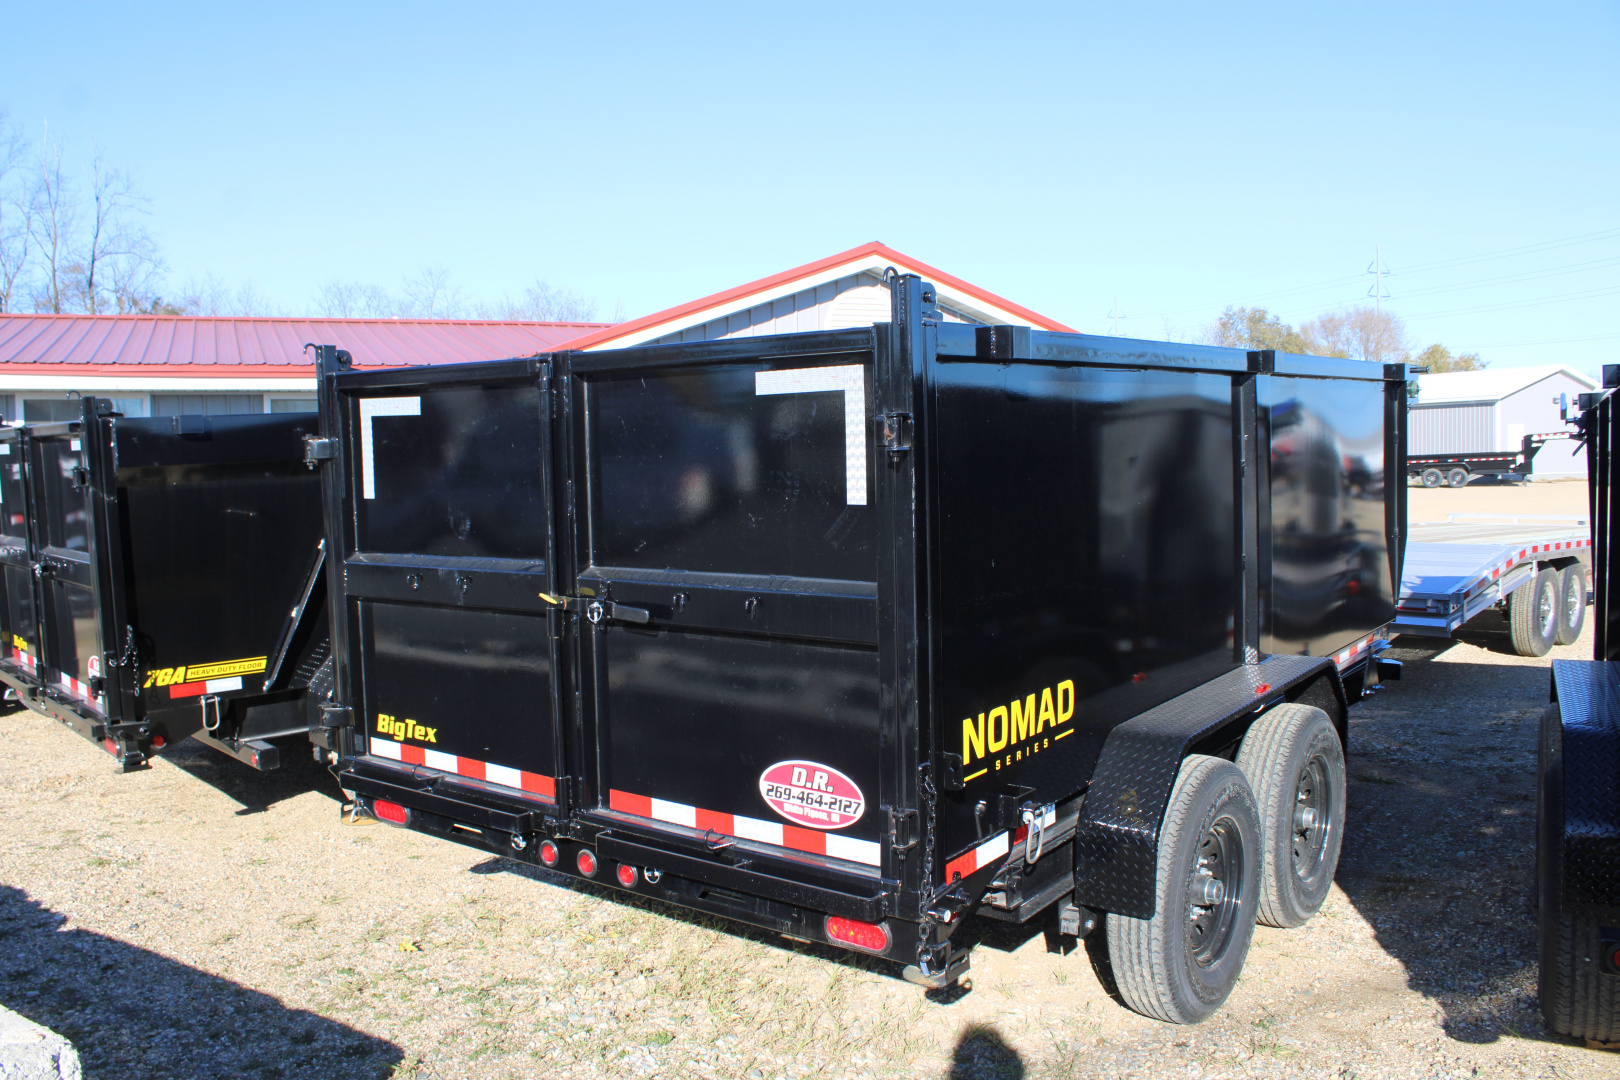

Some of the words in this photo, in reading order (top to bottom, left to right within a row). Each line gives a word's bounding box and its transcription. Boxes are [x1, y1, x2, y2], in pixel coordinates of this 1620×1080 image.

[190, 668, 216, 676] HEAVY
[217, 665, 237, 673] DUTY
[238, 662, 262, 670] FLOOR
[377, 713, 437, 743] BigTex
[963, 679, 1075, 766] NOMAD
[995, 738, 1049, 771] SERIES
[791, 766, 834, 793] D.R.
[766, 784, 861, 815] 269-464-2127
